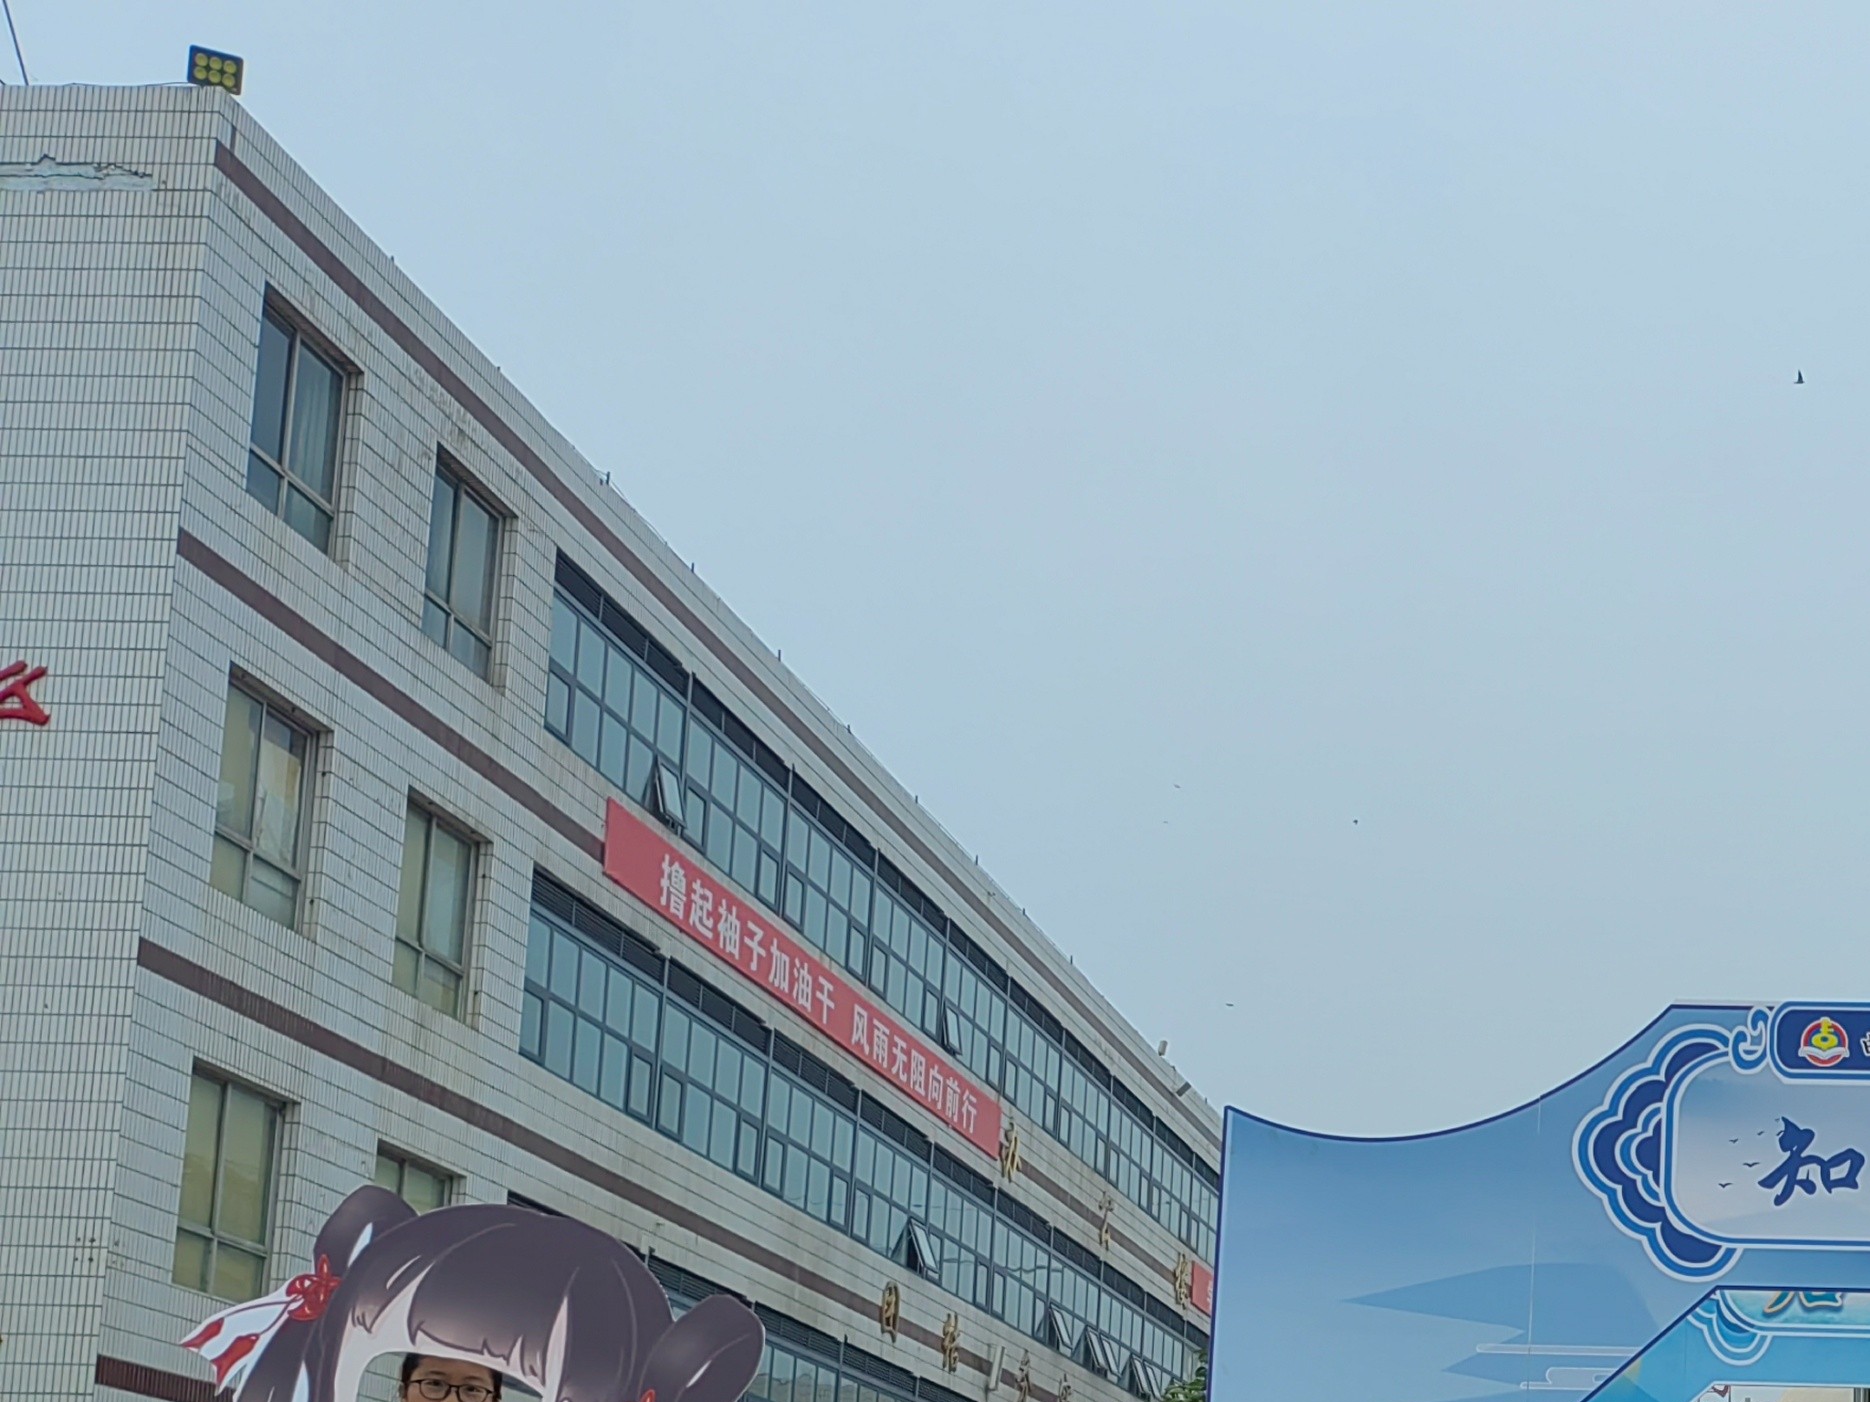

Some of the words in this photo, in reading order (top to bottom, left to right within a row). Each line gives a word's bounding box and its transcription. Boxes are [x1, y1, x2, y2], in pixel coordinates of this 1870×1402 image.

[660, 853, 836, 1026] 撸起袖子加油干
[851, 1003, 978, 1134] 风雨无阻向前行
